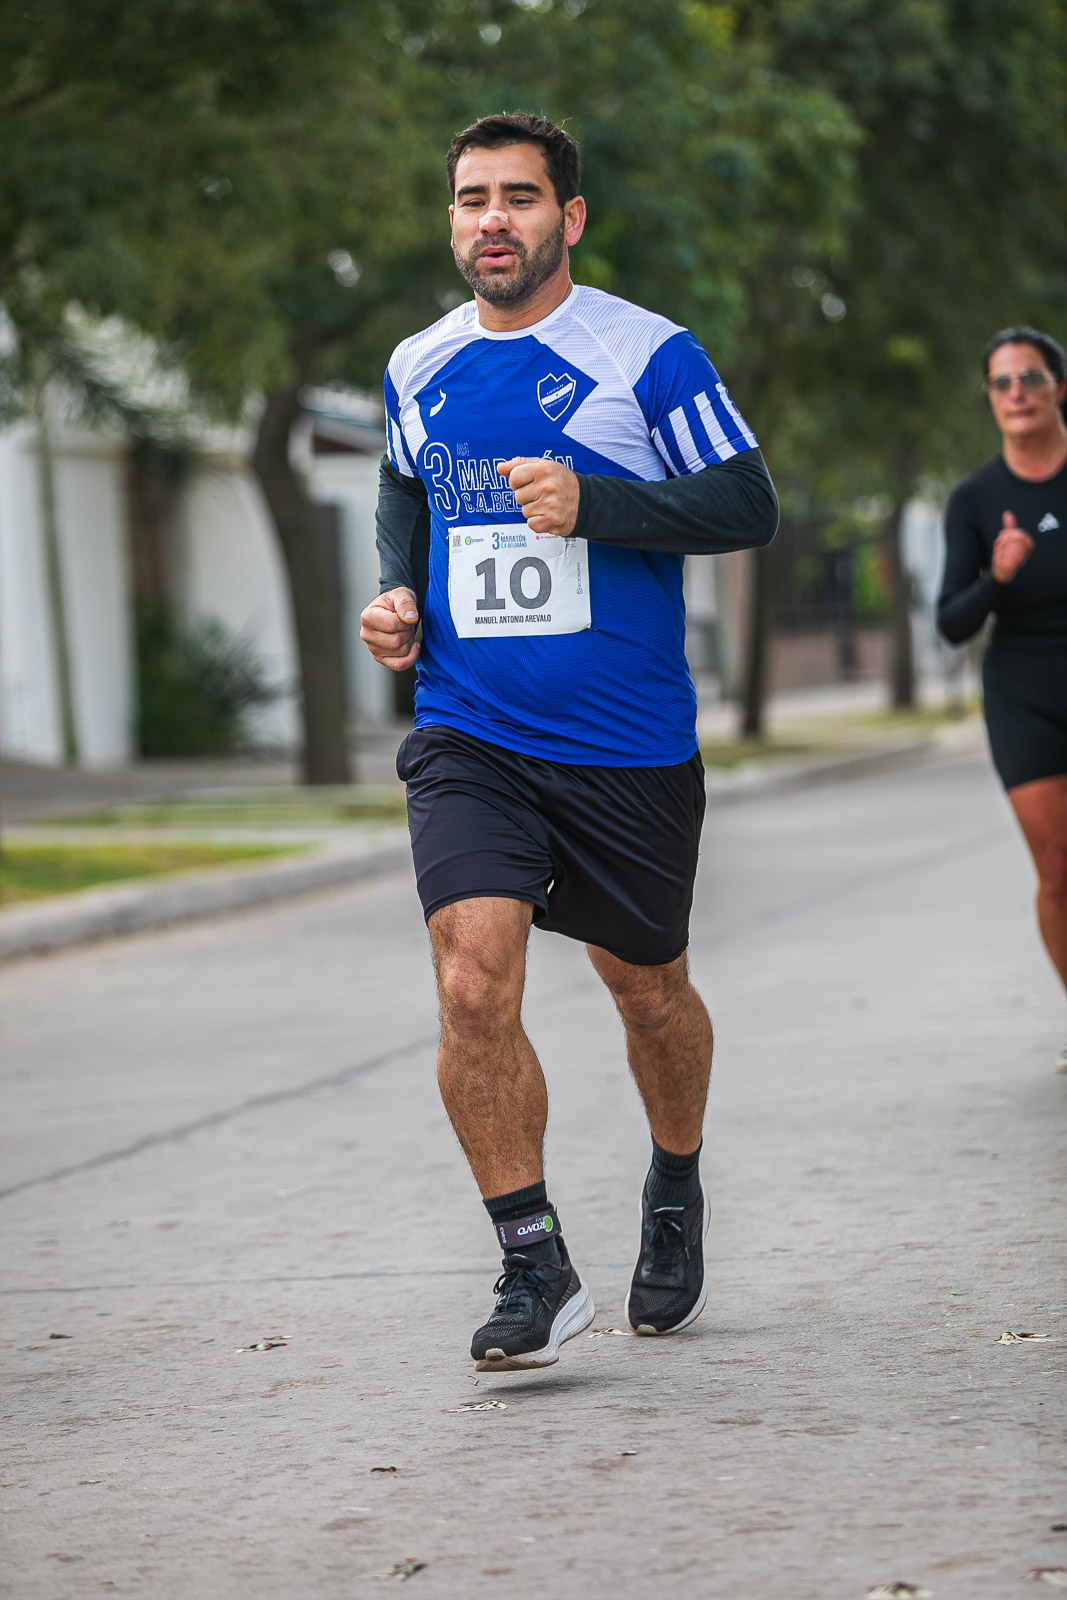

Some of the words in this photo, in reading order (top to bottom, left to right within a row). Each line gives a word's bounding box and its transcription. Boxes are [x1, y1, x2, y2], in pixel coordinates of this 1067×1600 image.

[424, 442, 460, 520] 3
[491, 531, 500, 550] 3
[500, 534, 526, 543] MARATÓN
[475, 556, 552, 611] 10
[475, 616, 498, 625] MANUEL
[499, 615, 524, 624] ANTONIO
[525, 614, 552, 623] AREVALO
